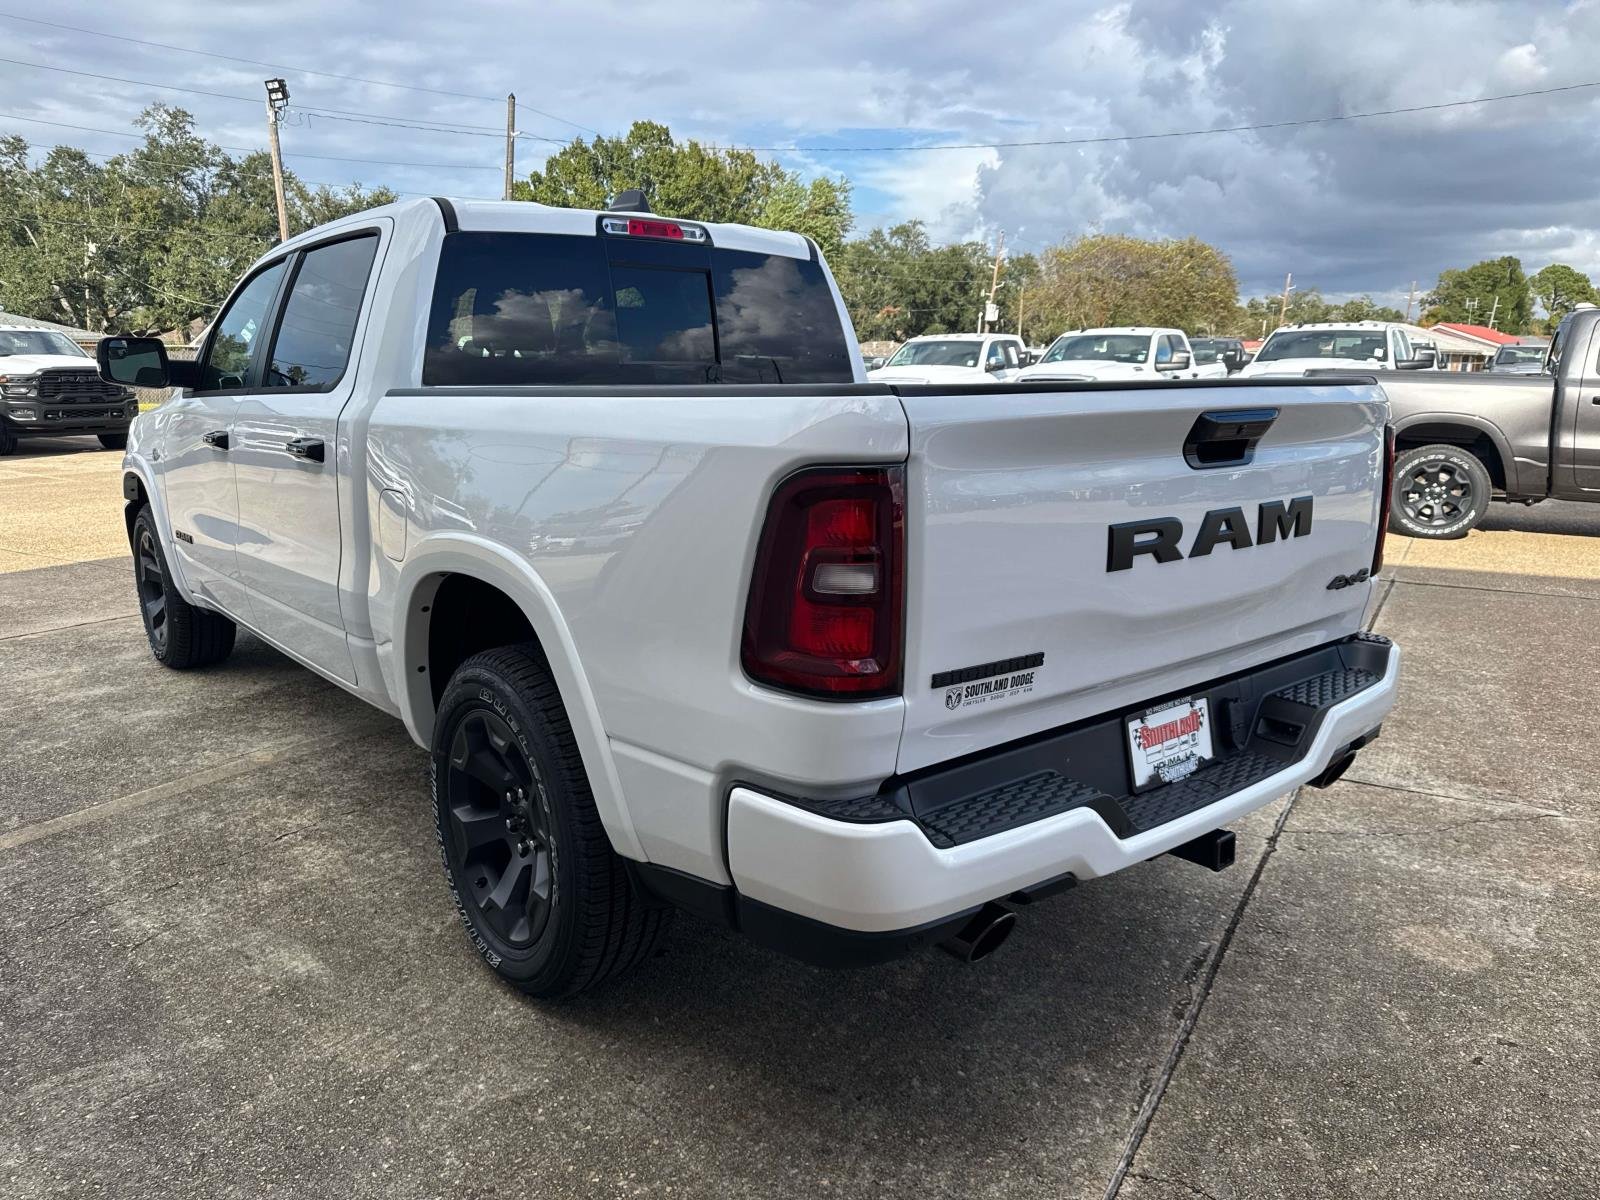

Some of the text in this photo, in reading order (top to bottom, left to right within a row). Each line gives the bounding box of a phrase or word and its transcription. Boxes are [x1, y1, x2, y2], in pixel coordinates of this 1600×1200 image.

[1106, 495, 1313, 572] RAM
[964, 677, 1009, 698] SOUTHLAND
[1010, 671, 1035, 688] DODGE
